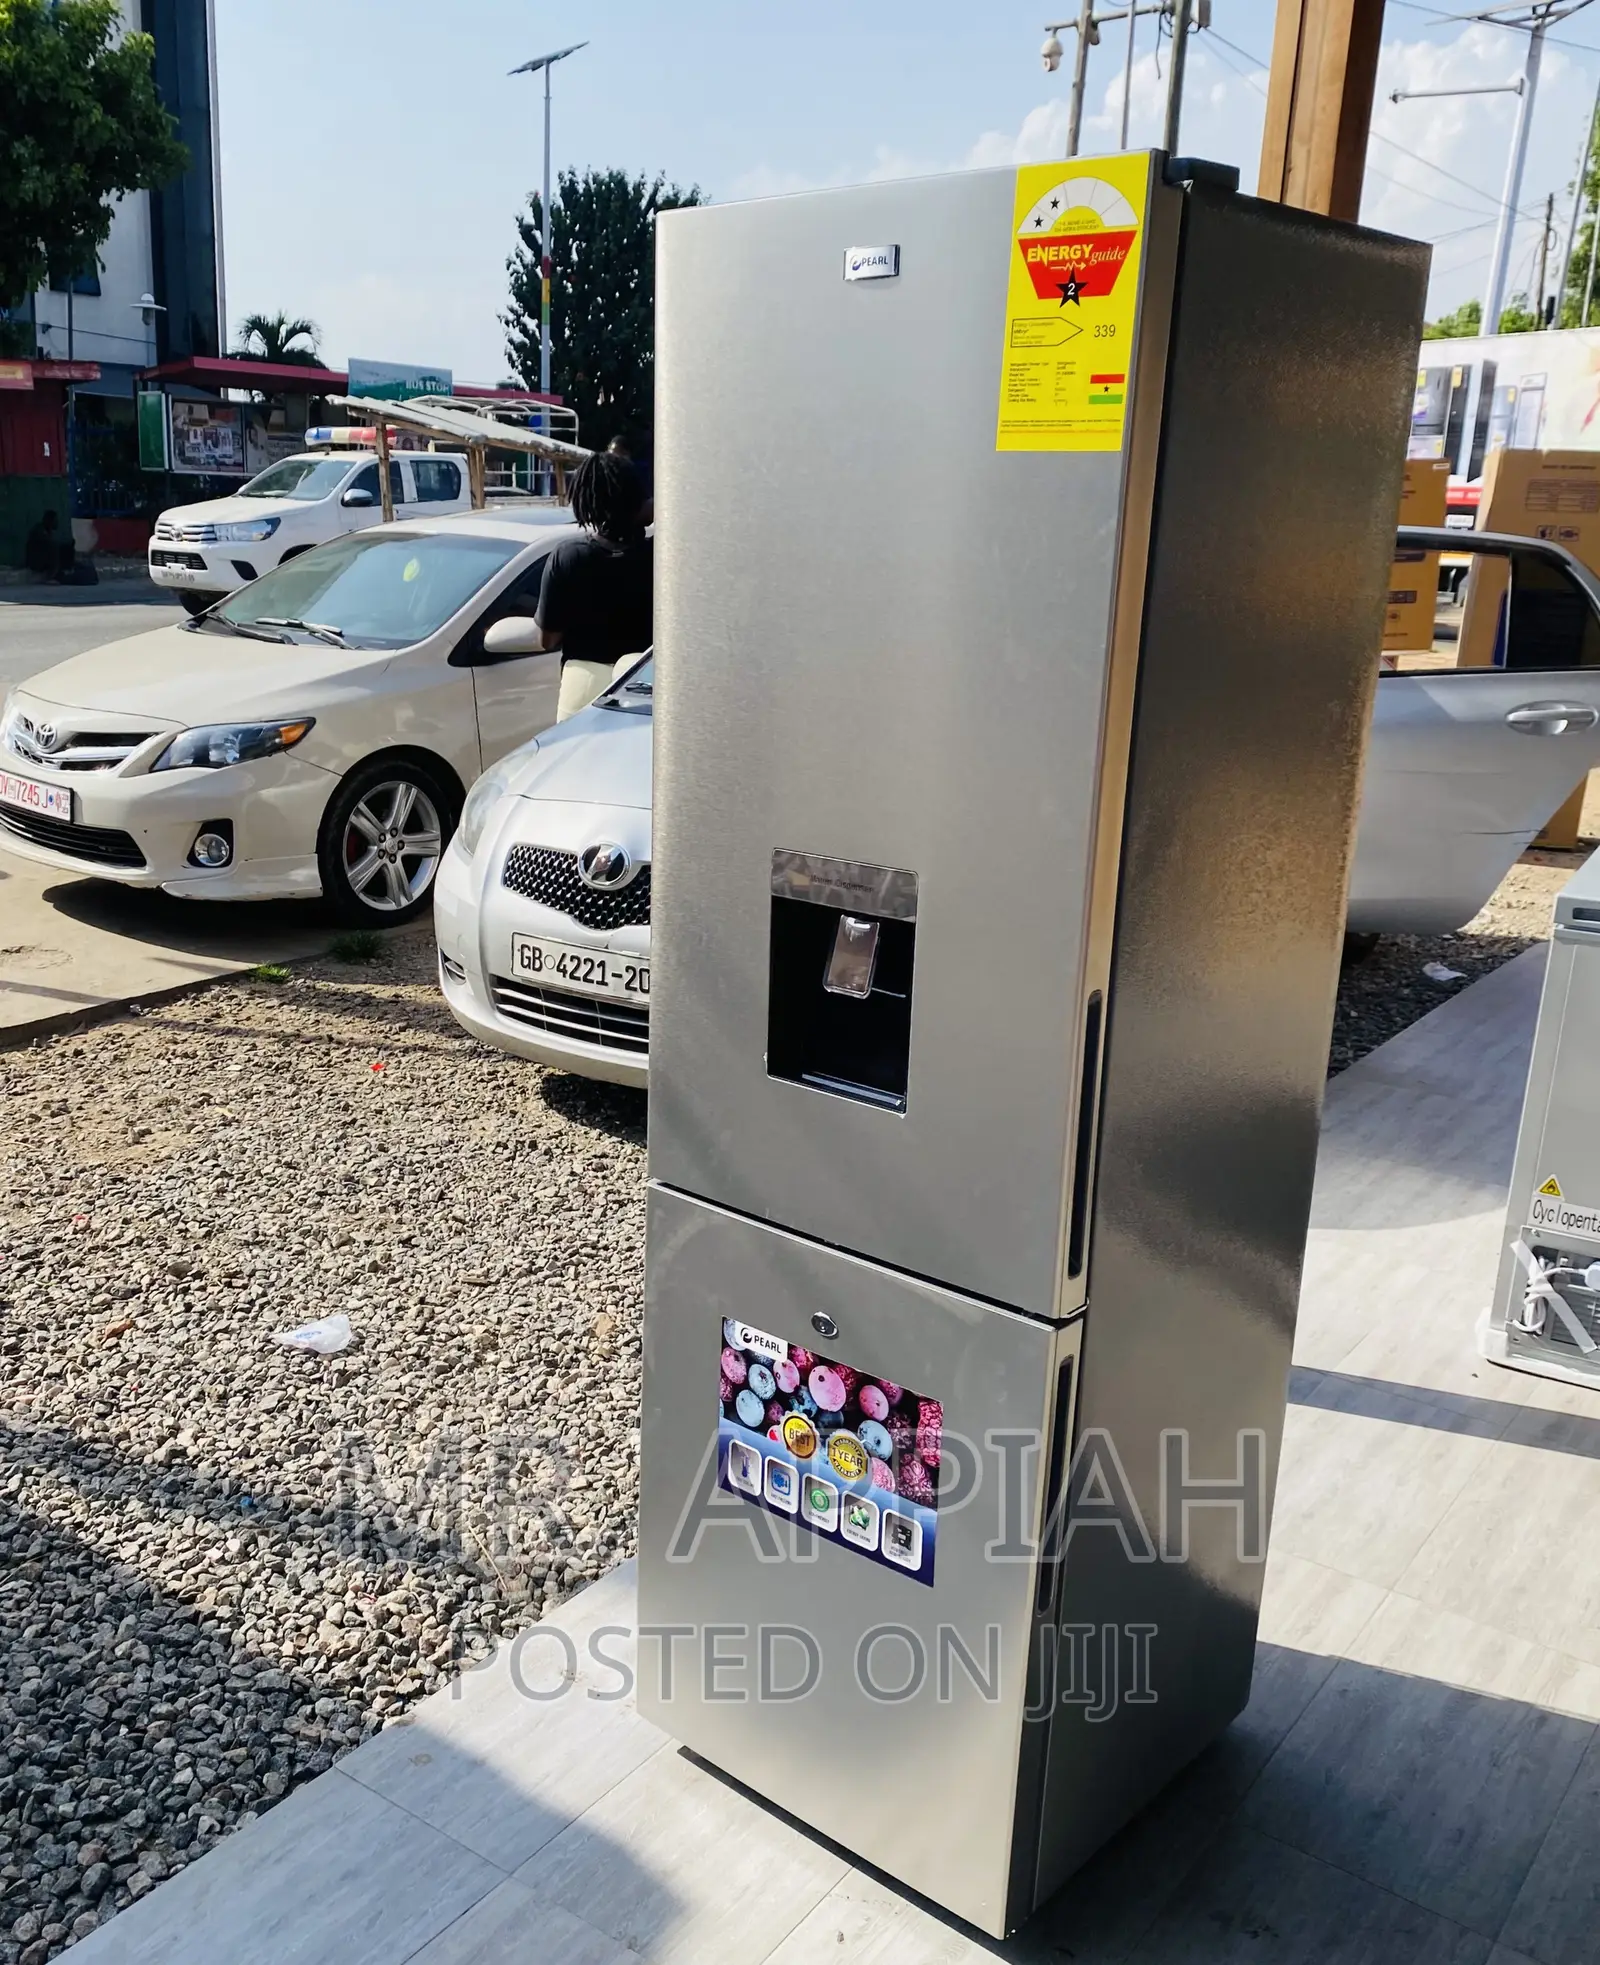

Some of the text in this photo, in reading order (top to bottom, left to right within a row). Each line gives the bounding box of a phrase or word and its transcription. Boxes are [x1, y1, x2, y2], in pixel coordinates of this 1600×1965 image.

[861, 255, 889, 267] PEARL
[1027, 243, 1126, 267] ENERGY guide
[1067, 283, 1076, 296] 2
[1093, 324, 1117, 339] 339
[405, 379, 425, 391] BUS
[15, 780, 40, 806] 7245
[520, 943, 650, 994] GB 4221-20
[753, 1334, 783, 1354] PEARL
[789, 1428, 811, 1447] BEST
[838, 1450, 863, 1469] YEAR
